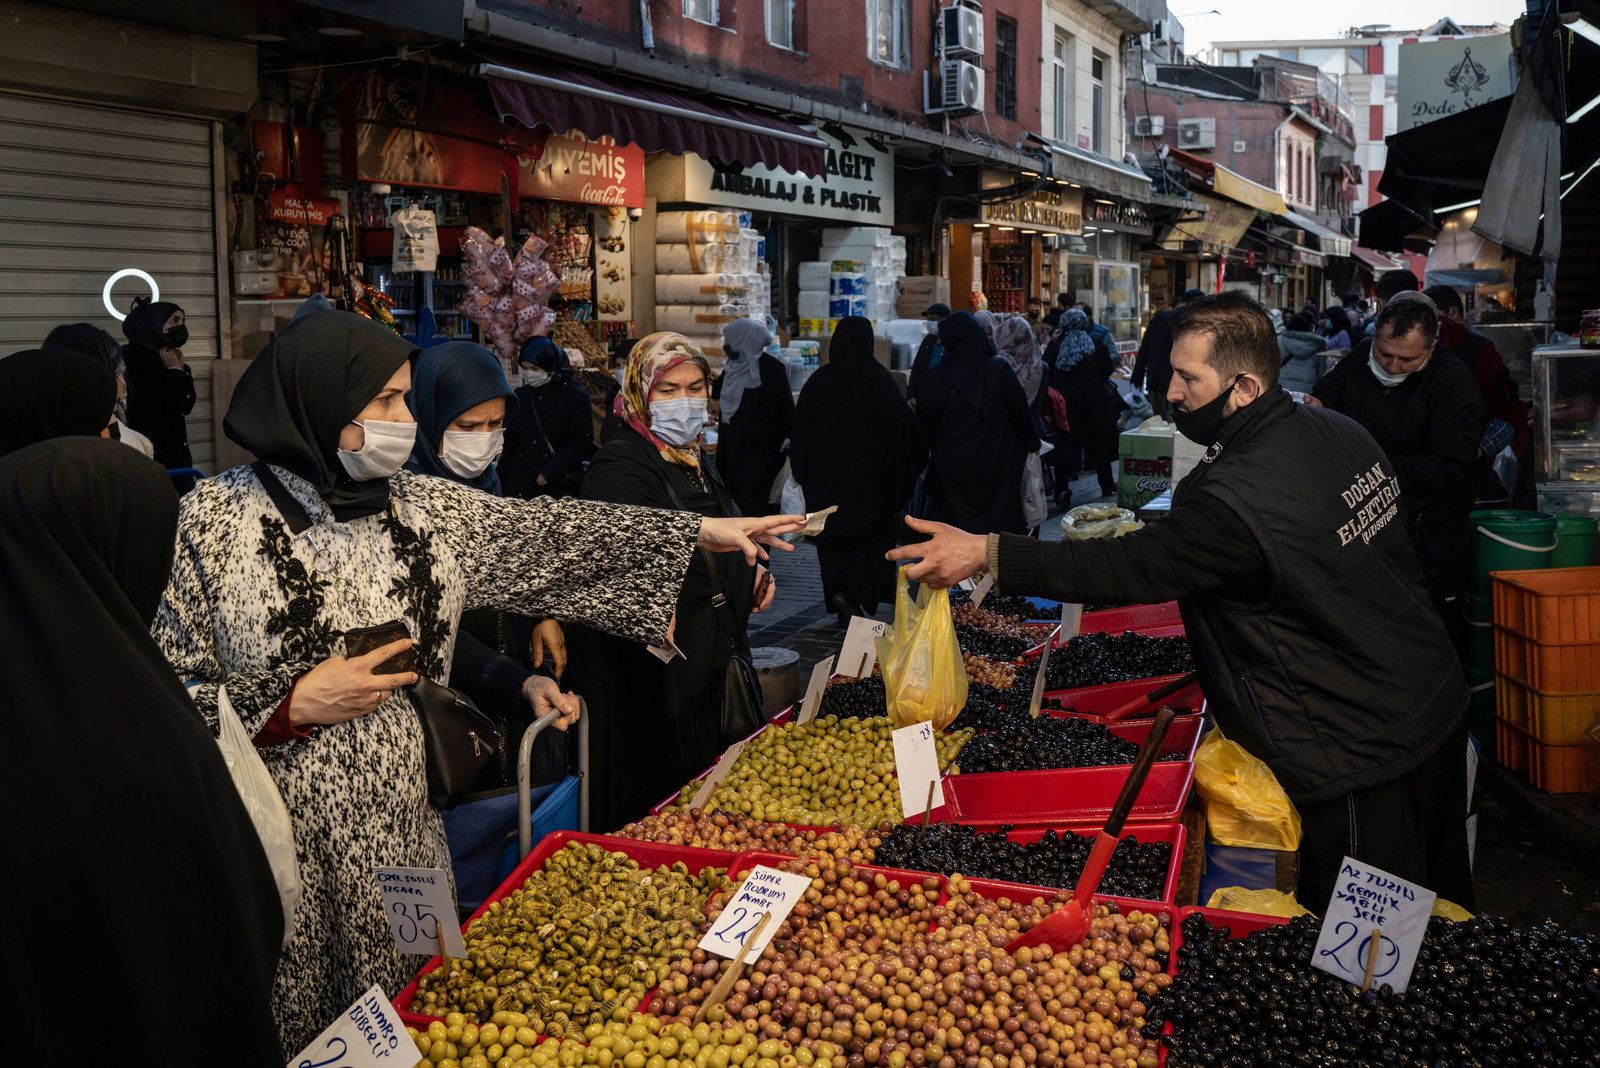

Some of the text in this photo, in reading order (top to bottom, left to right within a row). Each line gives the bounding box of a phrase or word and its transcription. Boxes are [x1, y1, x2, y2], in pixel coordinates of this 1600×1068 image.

[1411, 99, 1455, 116] Dede
[825, 143, 875, 181] AĞIT
[284, 199, 313, 209] MALA
[711, 171, 881, 213] AMBALAJ & PLASTİK
[1341, 462, 1388, 509] DOĞAN
[752, 870, 783, 885] SÜPER
[1341, 864, 1361, 879] AZ
[738, 893, 773, 908] PEMBE
[744, 881, 786, 901] BODRUM
[1336, 890, 1384, 914] YAĞLI
[1347, 882, 1400, 911] GEMLİK
[392, 902, 438, 943] 35
[714, 907, 764, 951] 22
[1320, 921, 1400, 977] 20
[349, 1005, 390, 1059] BİBERLİ
[364, 996, 398, 1049] JUMBO
[289, 1037, 347, 1068] 2
